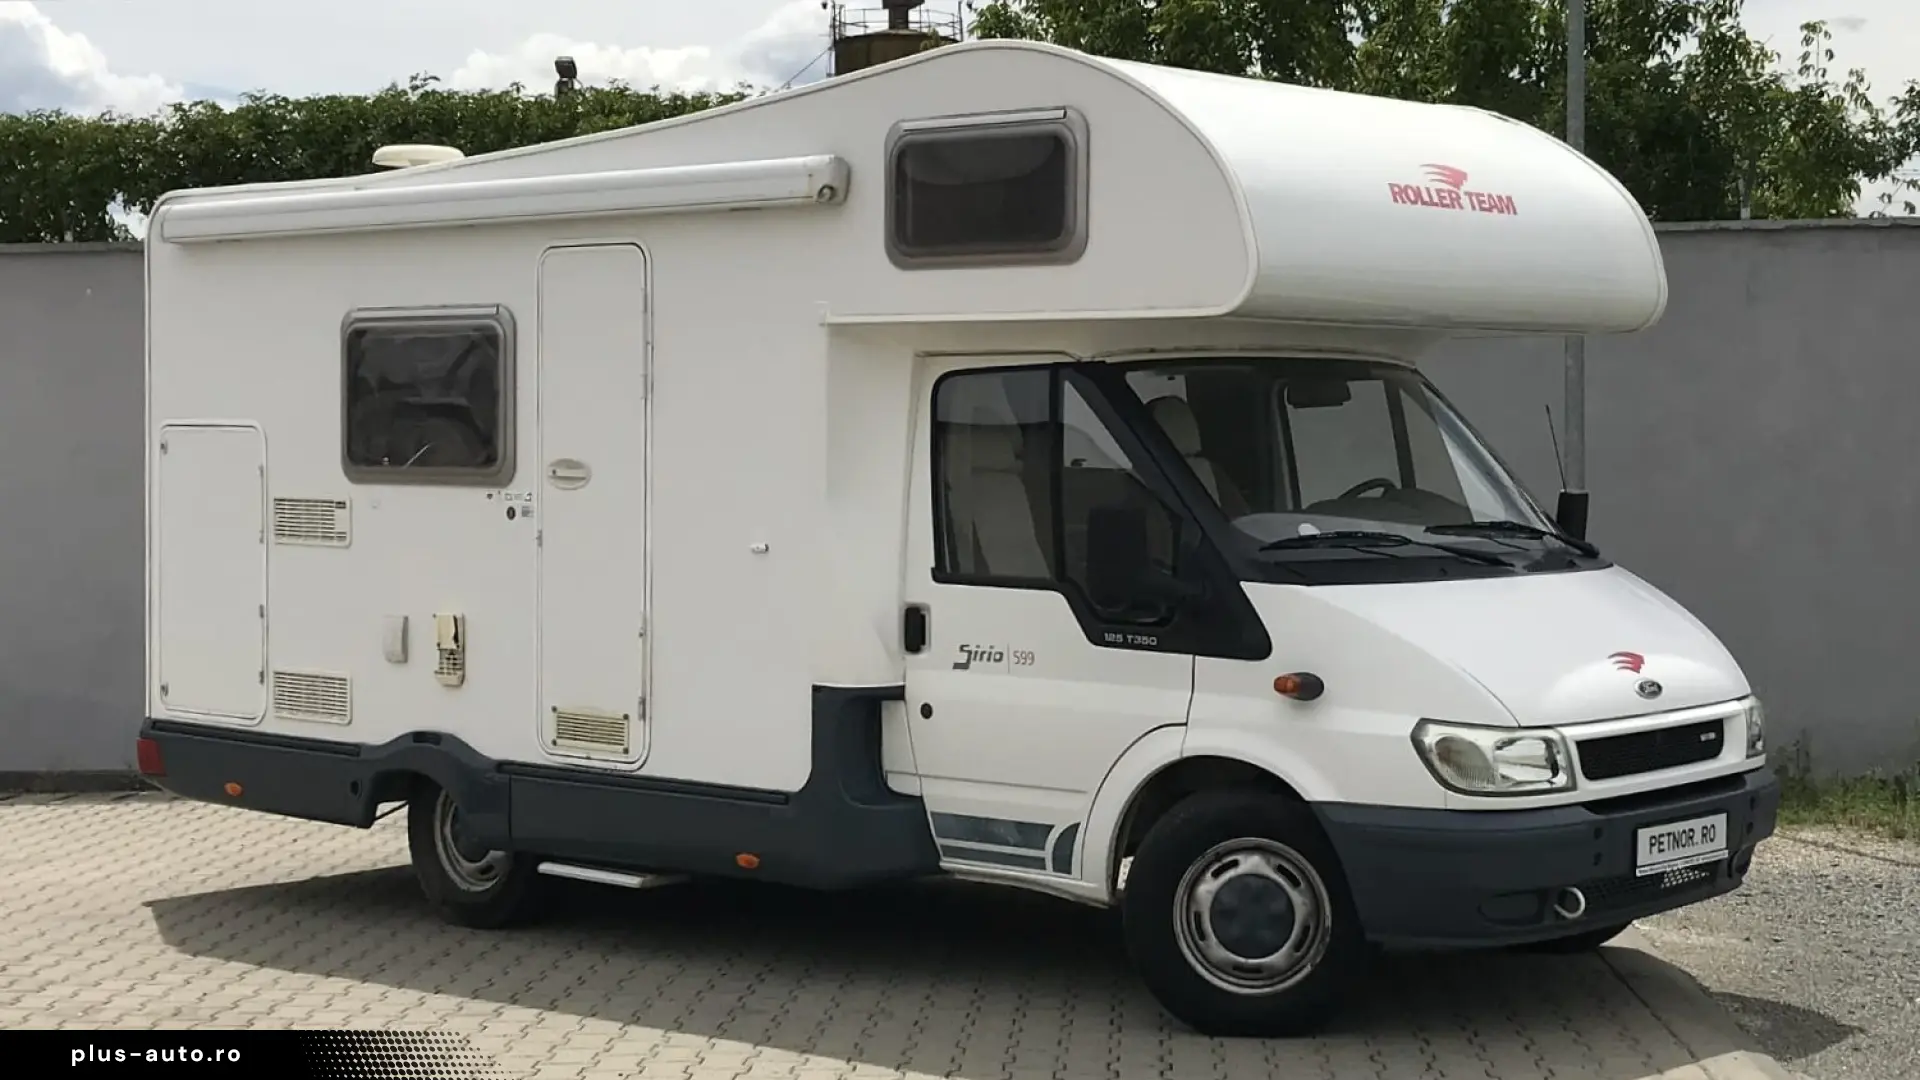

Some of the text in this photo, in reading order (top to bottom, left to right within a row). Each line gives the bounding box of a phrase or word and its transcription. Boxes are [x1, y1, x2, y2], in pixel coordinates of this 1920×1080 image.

[1387, 182, 1518, 215] ROLLER TEAM
[952, 644, 1035, 670] Sirio 599
